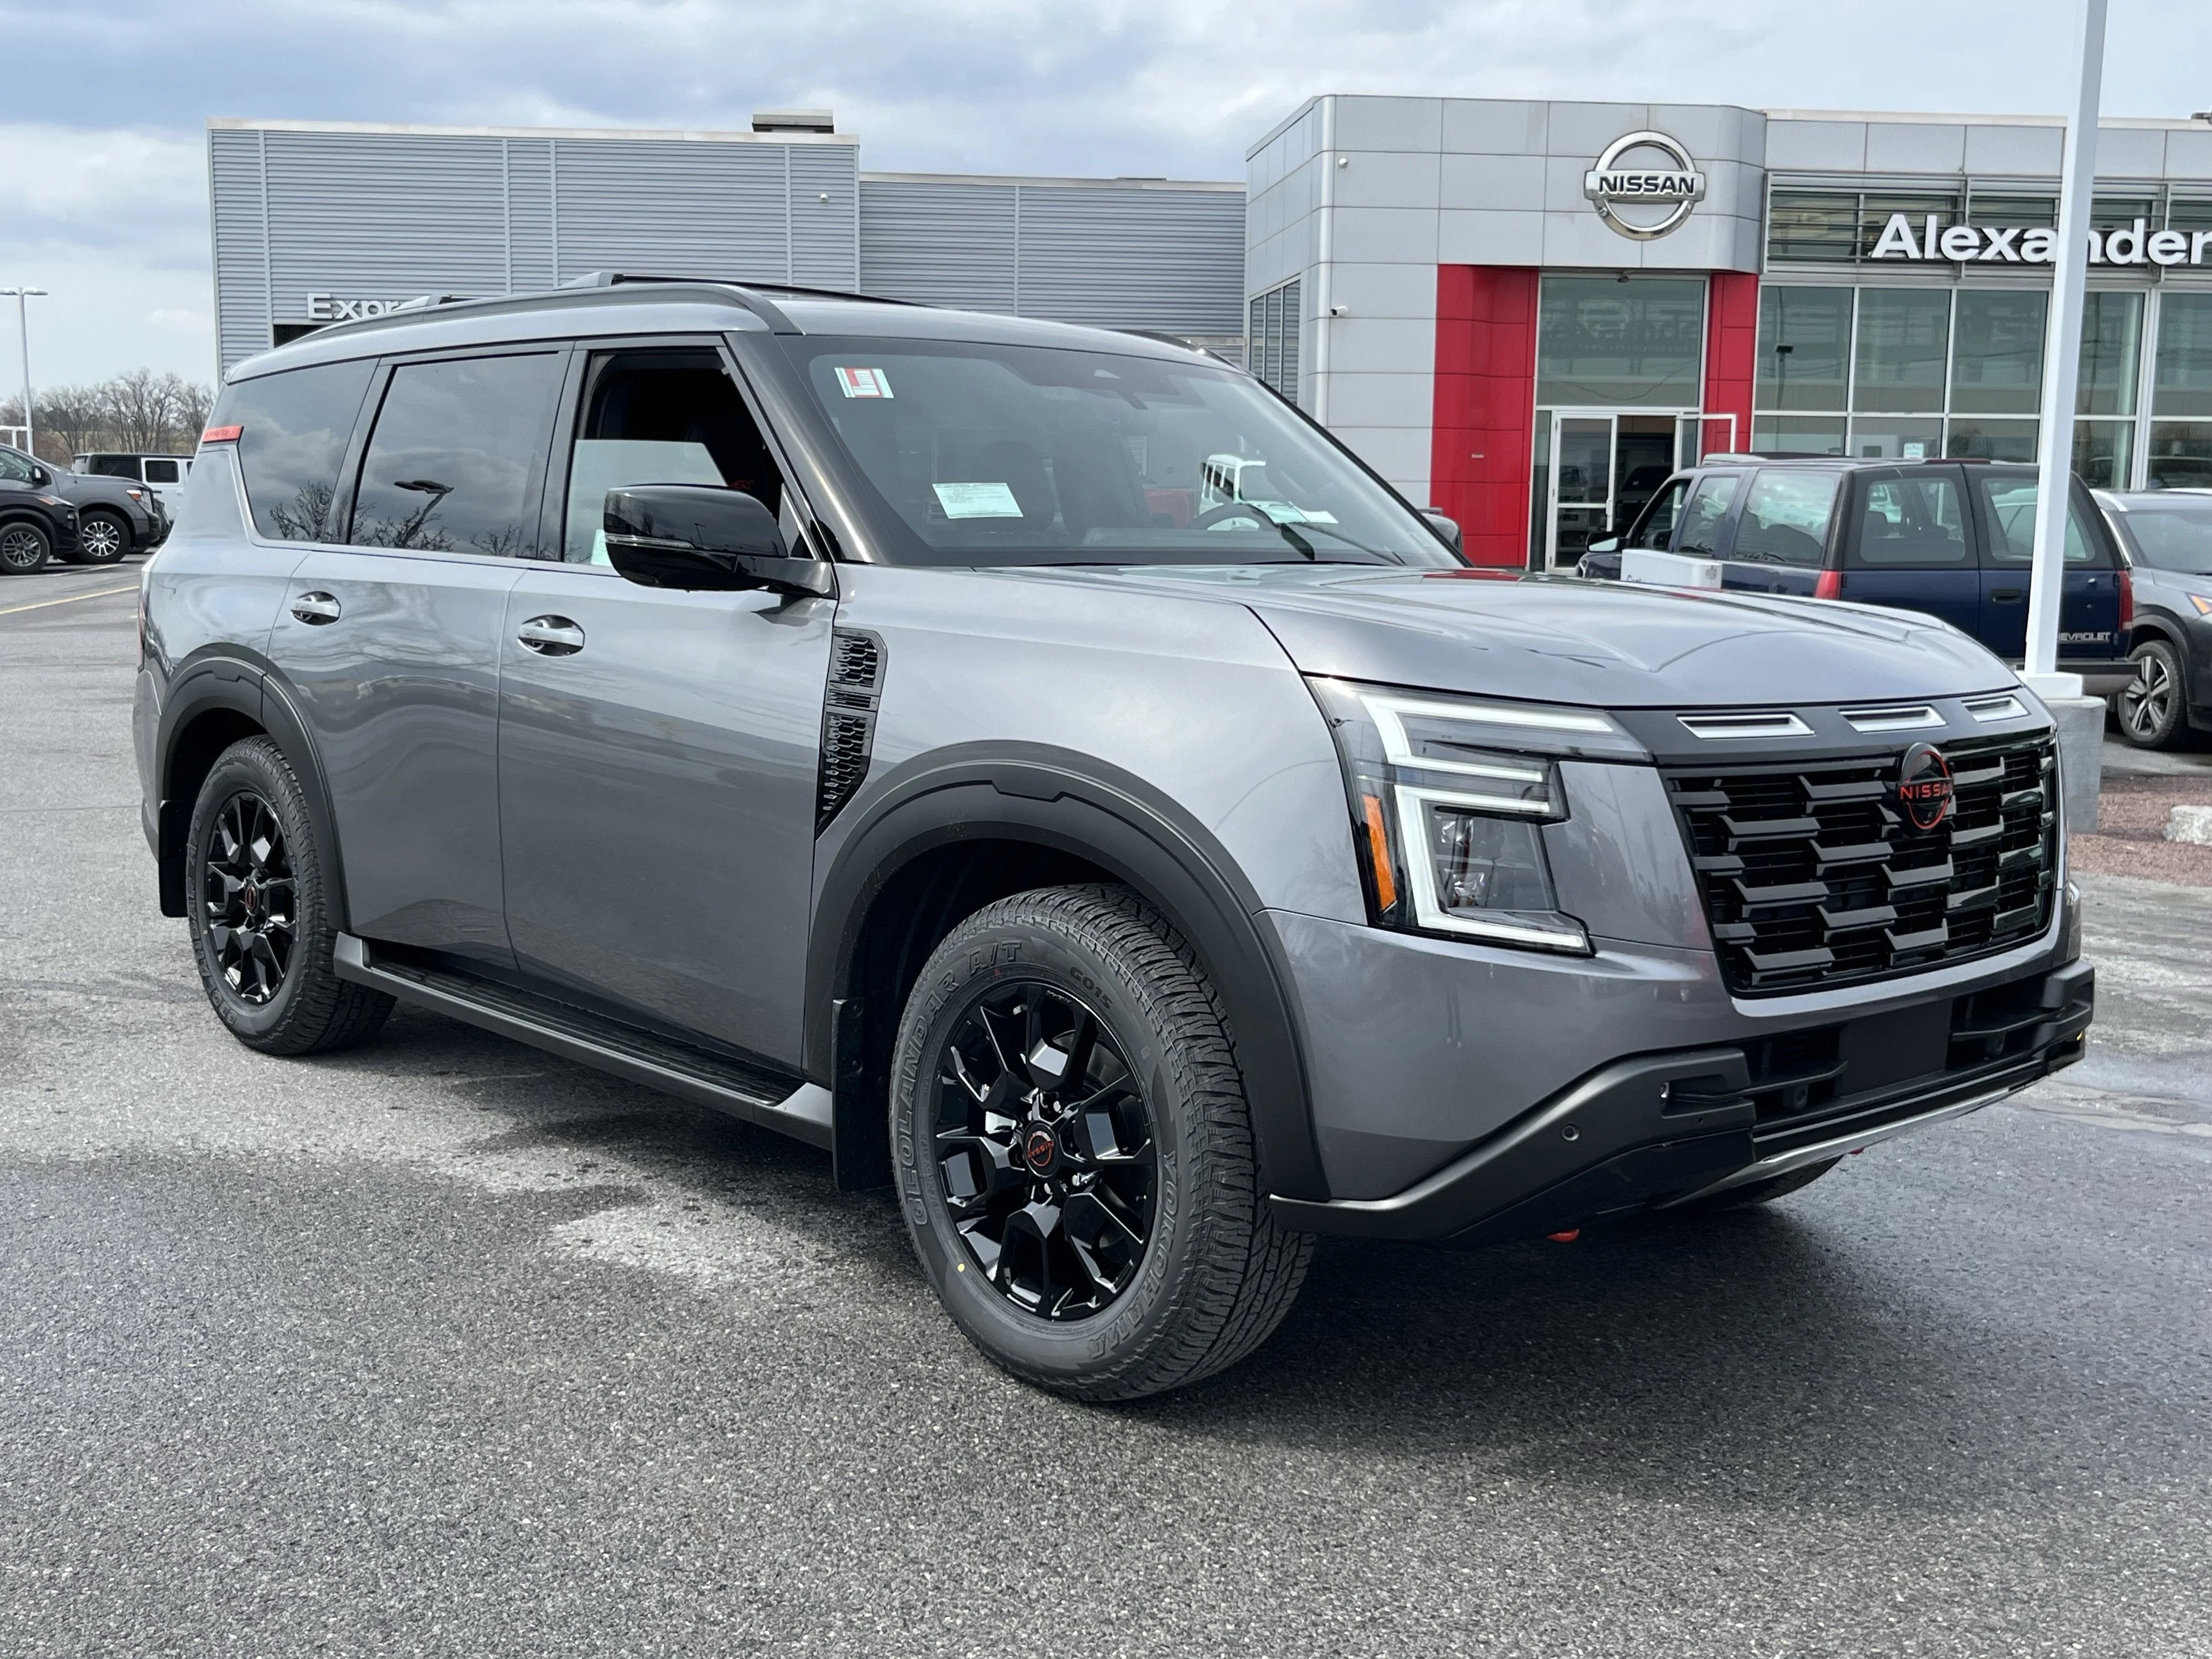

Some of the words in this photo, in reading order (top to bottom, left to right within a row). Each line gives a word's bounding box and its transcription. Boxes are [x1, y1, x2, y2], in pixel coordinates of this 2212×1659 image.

[1599, 175, 1695, 195] NISSAN
[307, 292, 400, 320] Expr
[2058, 631, 2111, 641] EVROLET
[898, 968, 960, 1226] GEOLANDAR
[967, 939, 1022, 977] A/T
[1087, 1150, 1179, 1359] YOKOHAMA
